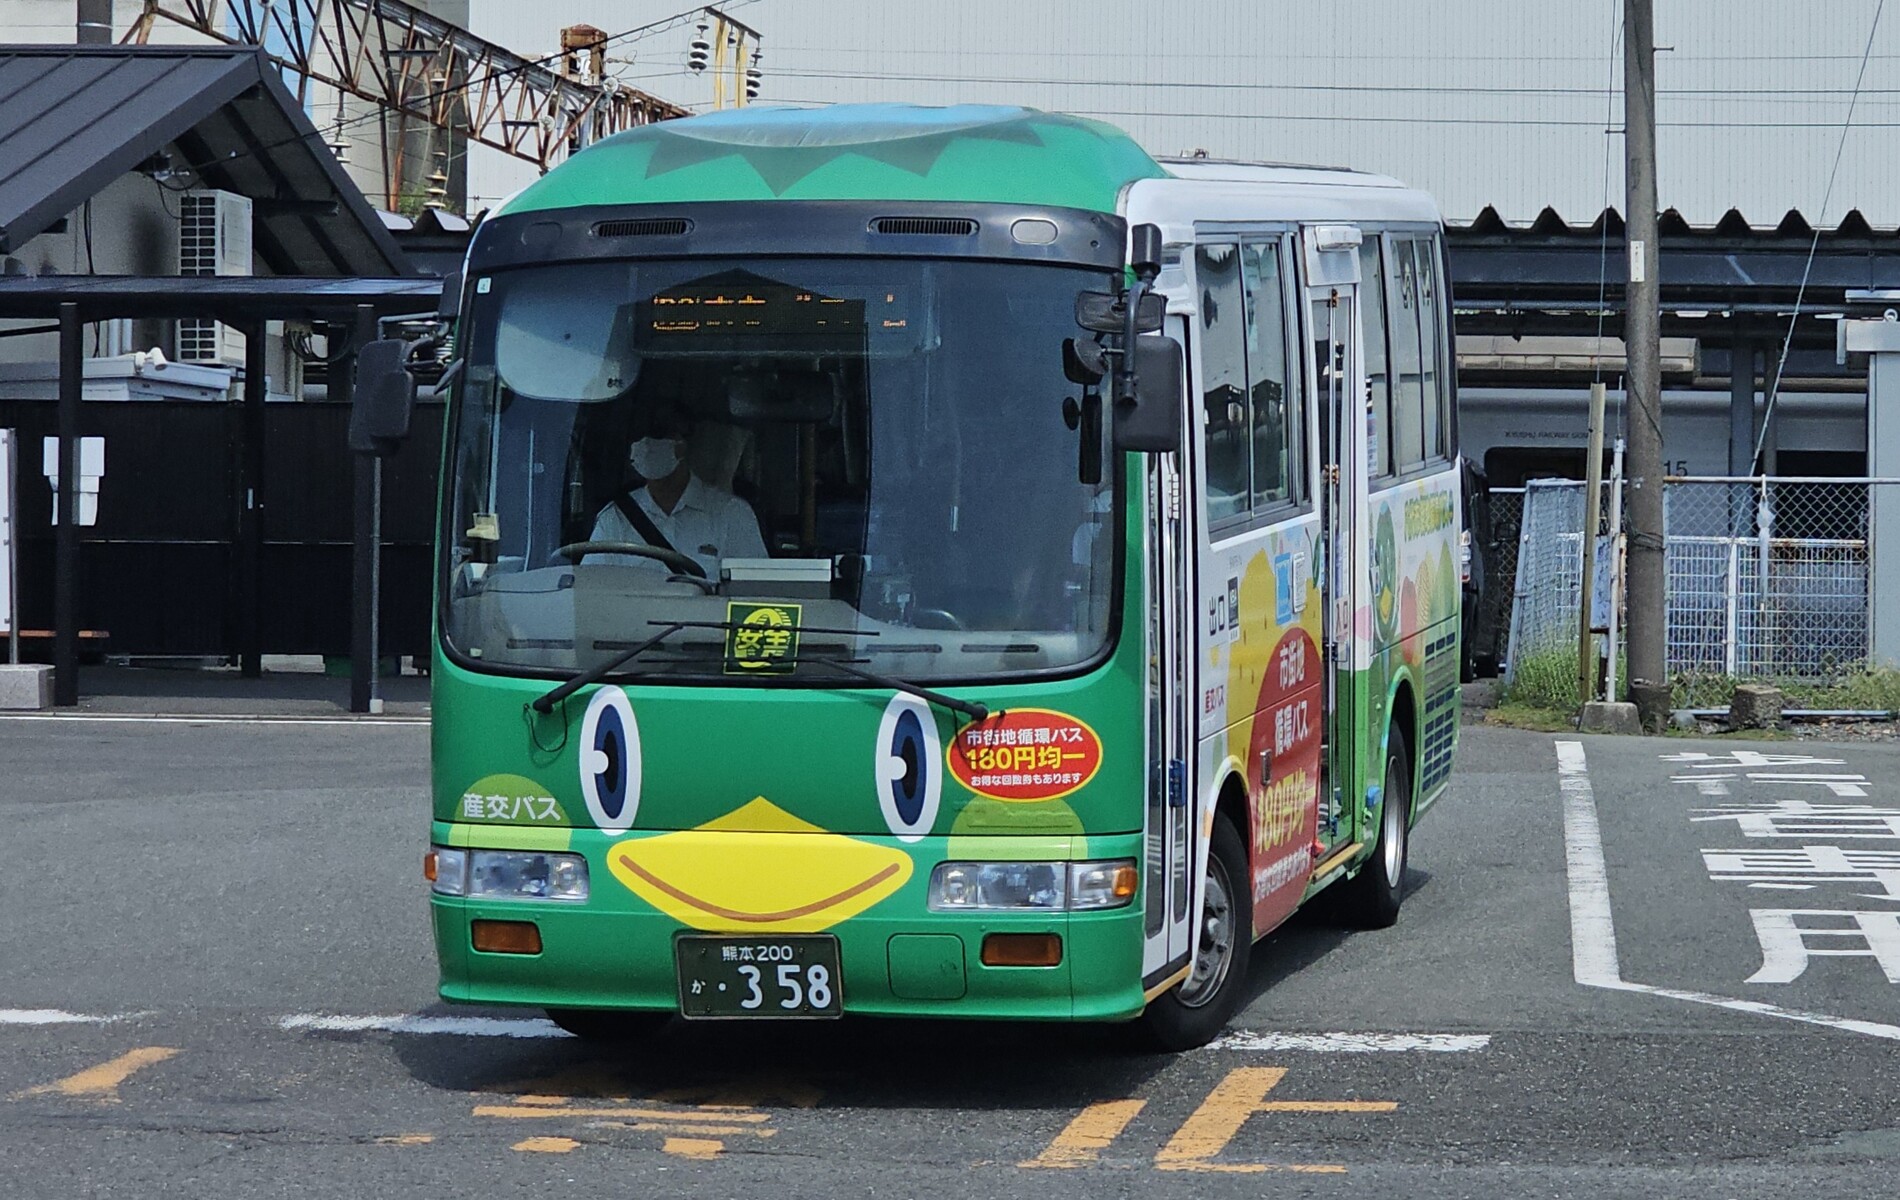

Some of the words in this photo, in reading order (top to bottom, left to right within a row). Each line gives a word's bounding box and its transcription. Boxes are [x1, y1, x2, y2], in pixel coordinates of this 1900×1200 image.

[1209, 595, 1225, 636] 出口
[966, 727, 1083, 746] 市街地循環バス
[966, 746, 1086, 770] 180円均一
[971, 772, 1082, 786] お得な回数券もあります
[463, 793, 561, 820] 産交バス
